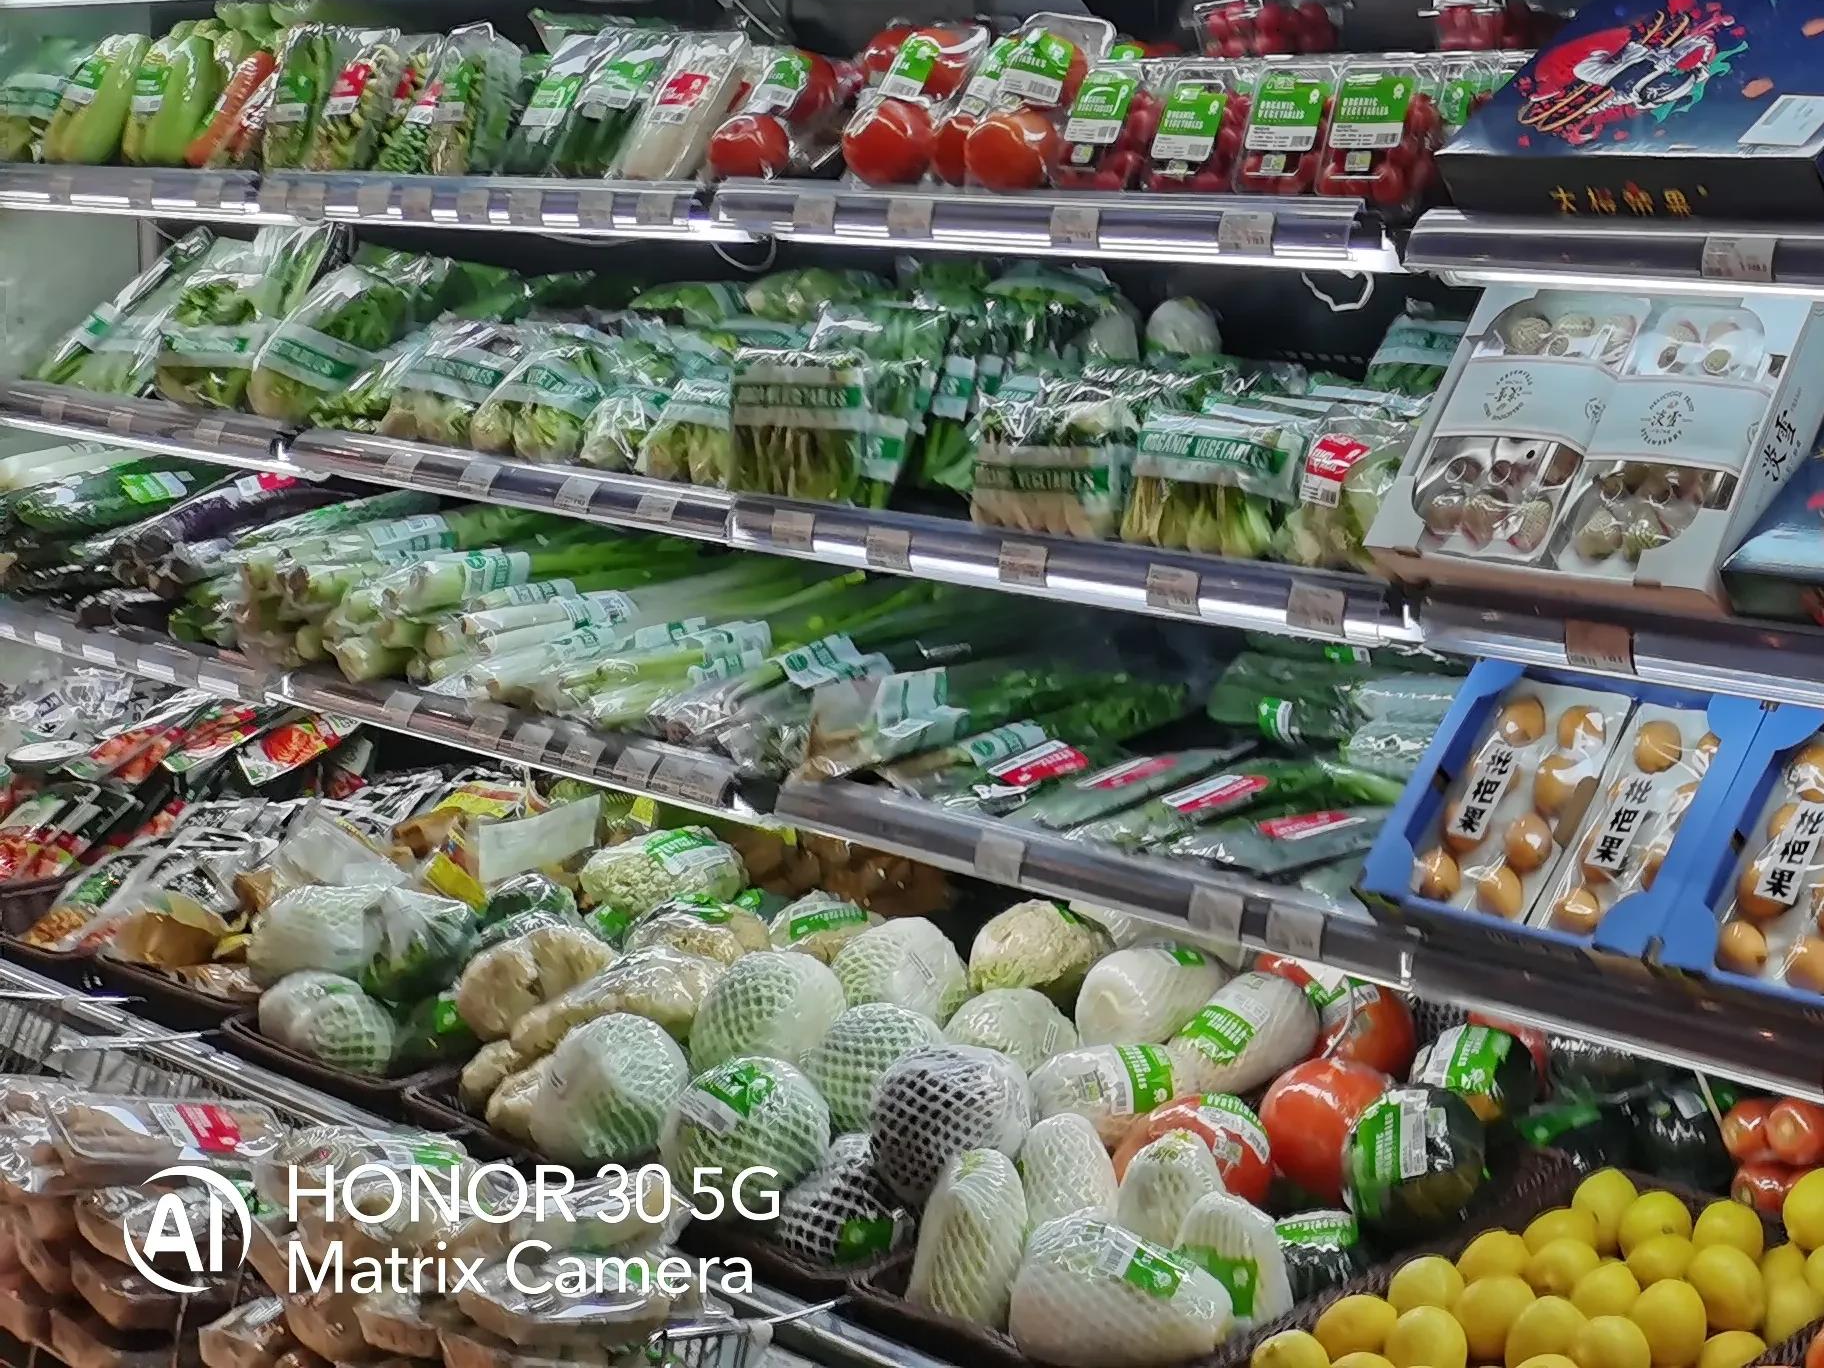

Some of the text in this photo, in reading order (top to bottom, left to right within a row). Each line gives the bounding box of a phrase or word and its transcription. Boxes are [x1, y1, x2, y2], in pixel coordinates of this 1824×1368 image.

[1260, 100, 1295, 110] ORGANIC
[1342, 97, 1379, 107] ORGANIC
[1257, 108, 1306, 119] VEGETABLES
[1340, 106, 1390, 116] VEGETABLES
[1142, 433, 1193, 455] ORGANIC
[1594, 777, 1654, 864] 枇杷果
[1762, 807, 1824, 899] 枇杷果
